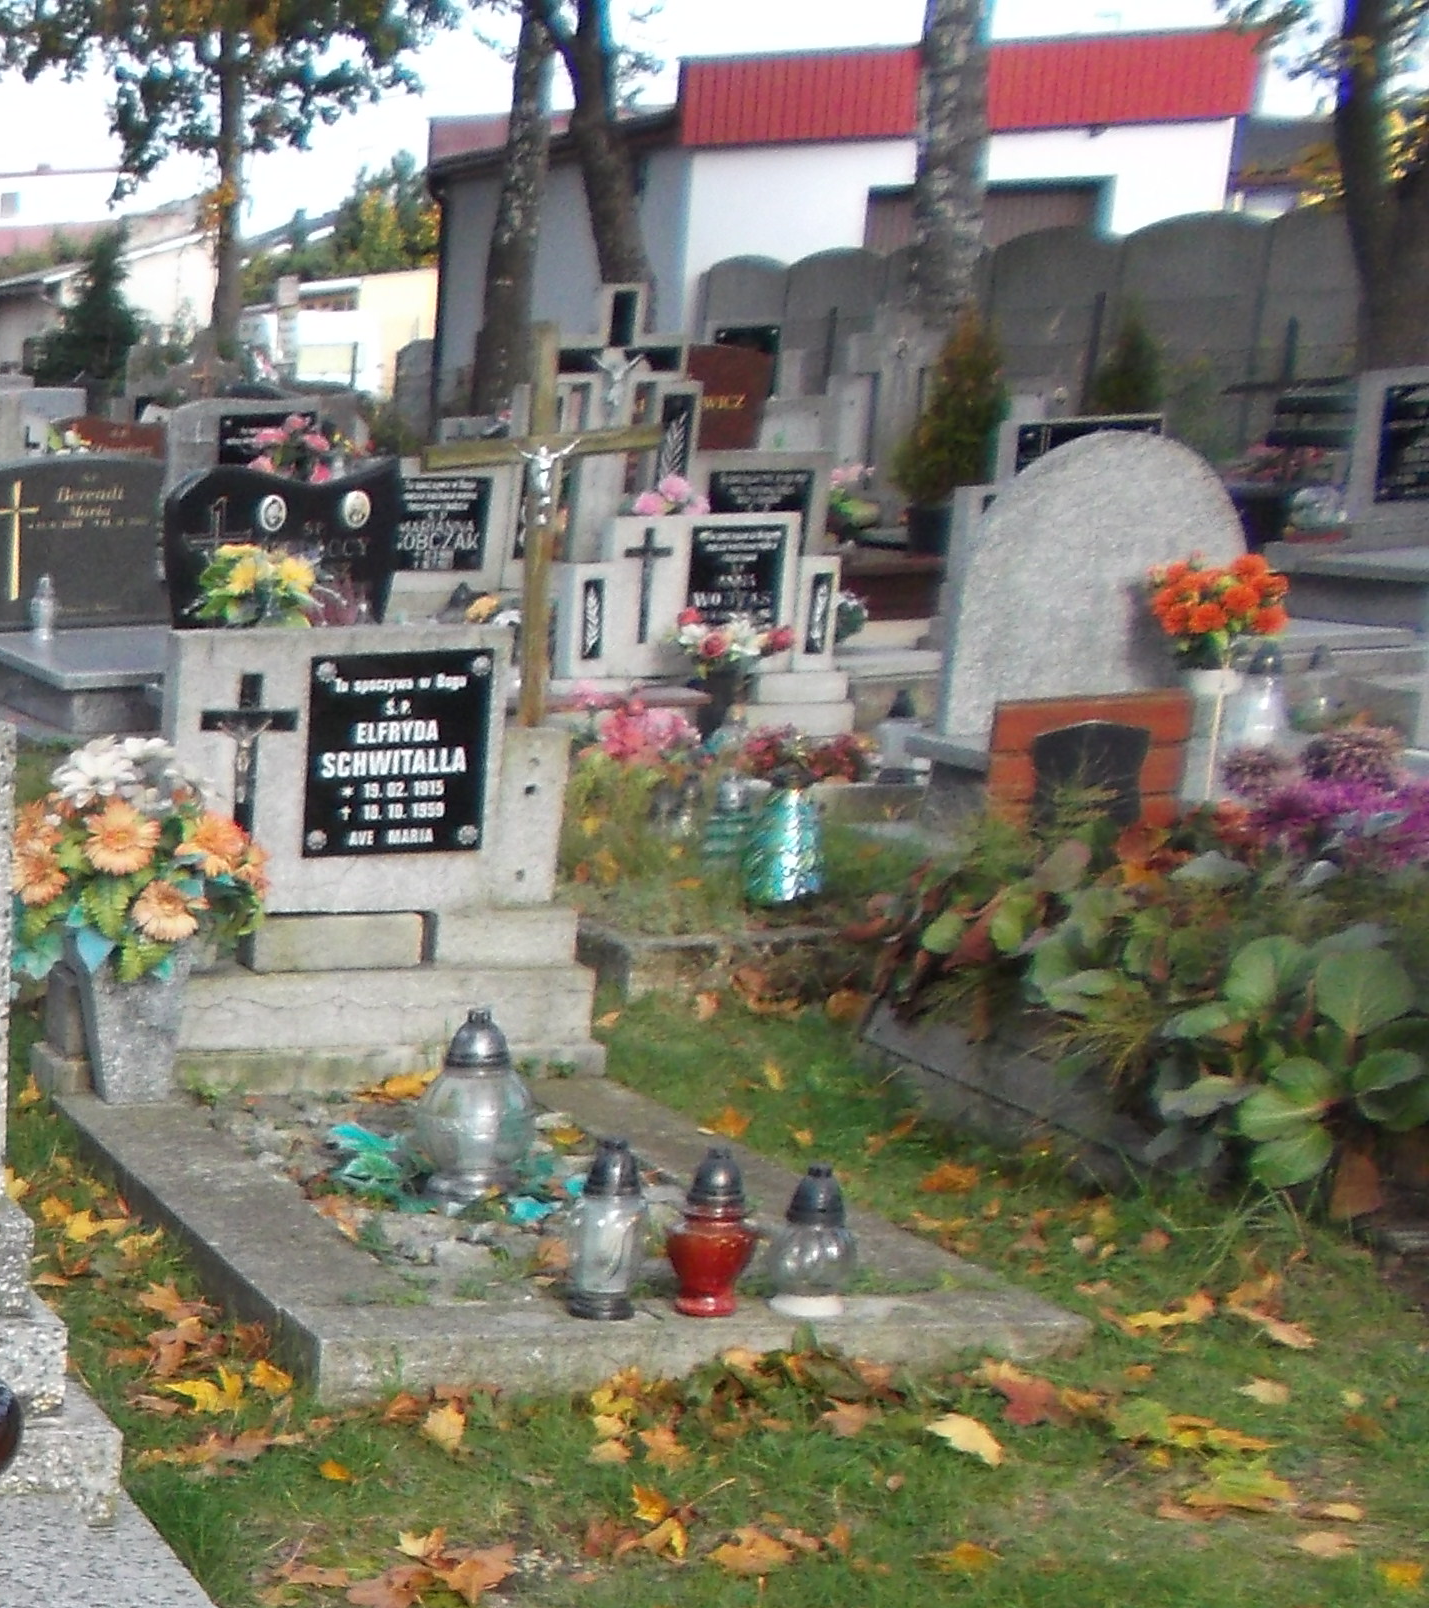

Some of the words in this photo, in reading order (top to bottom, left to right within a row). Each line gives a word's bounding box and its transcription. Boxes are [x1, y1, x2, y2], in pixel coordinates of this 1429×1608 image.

[356, 719, 440, 744] ELFRYDA
[321, 746, 467, 779] SCHWITALLA
[348, 829, 375, 847] AVE
[387, 828, 434, 845] MARIA
